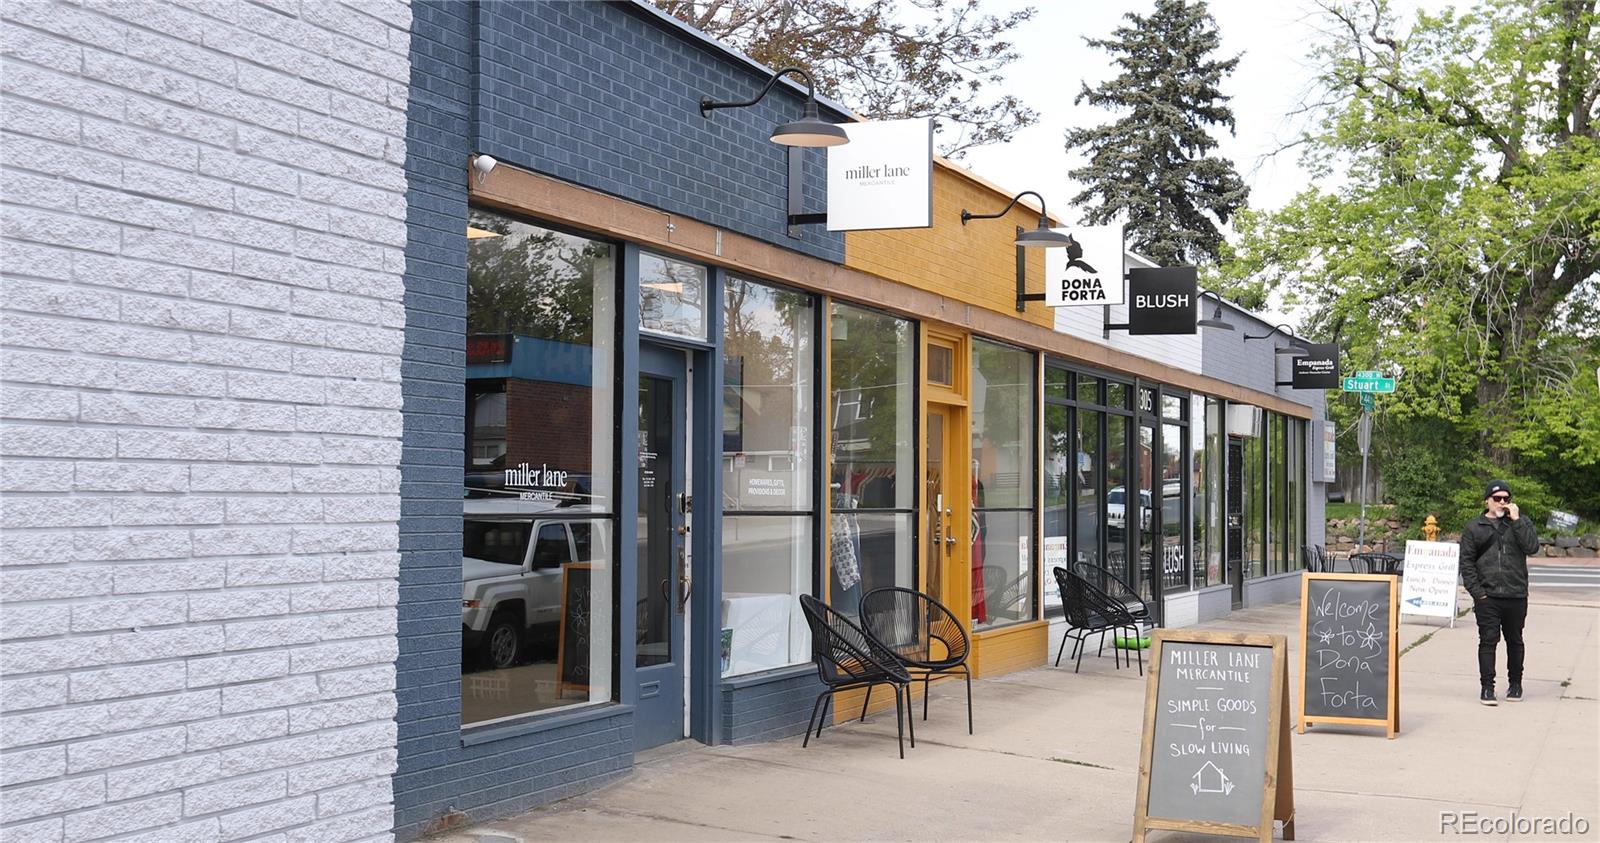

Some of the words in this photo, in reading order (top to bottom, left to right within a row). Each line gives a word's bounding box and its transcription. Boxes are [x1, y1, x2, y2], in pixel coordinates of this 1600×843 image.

[845, 165, 880, 180] miller
[884, 164, 910, 177] lane
[1061, 278, 1102, 290] DONA
[1061, 289, 1106, 301] FORTA
[1136, 294, 1189, 309] BLUSH
[1297, 358, 1333, 367] Empanada
[1347, 379, 1379, 390] Stuart
[1139, 388, 1152, 411] 305
[504, 462, 540, 486] miller
[542, 463, 568, 487] lane
[520, 492, 553, 501] MERCANTILE
[1163, 545, 1184, 574] LUSH
[1310, 587, 1379, 626] Welcome
[1336, 625, 1356, 646] to
[1170, 650, 1218, 666] MILLER
[1229, 652, 1260, 669] LANE
[1316, 649, 1373, 674] Dona
[1176, 668, 1250, 684] MERCANTILE
[1320, 677, 1377, 709] Forta
[1167, 699, 1210, 714] SIMPLE
[1217, 697, 1257, 714] GOODS
[1199, 717, 1216, 740] for
[1170, 743, 1206, 757] SLOW
